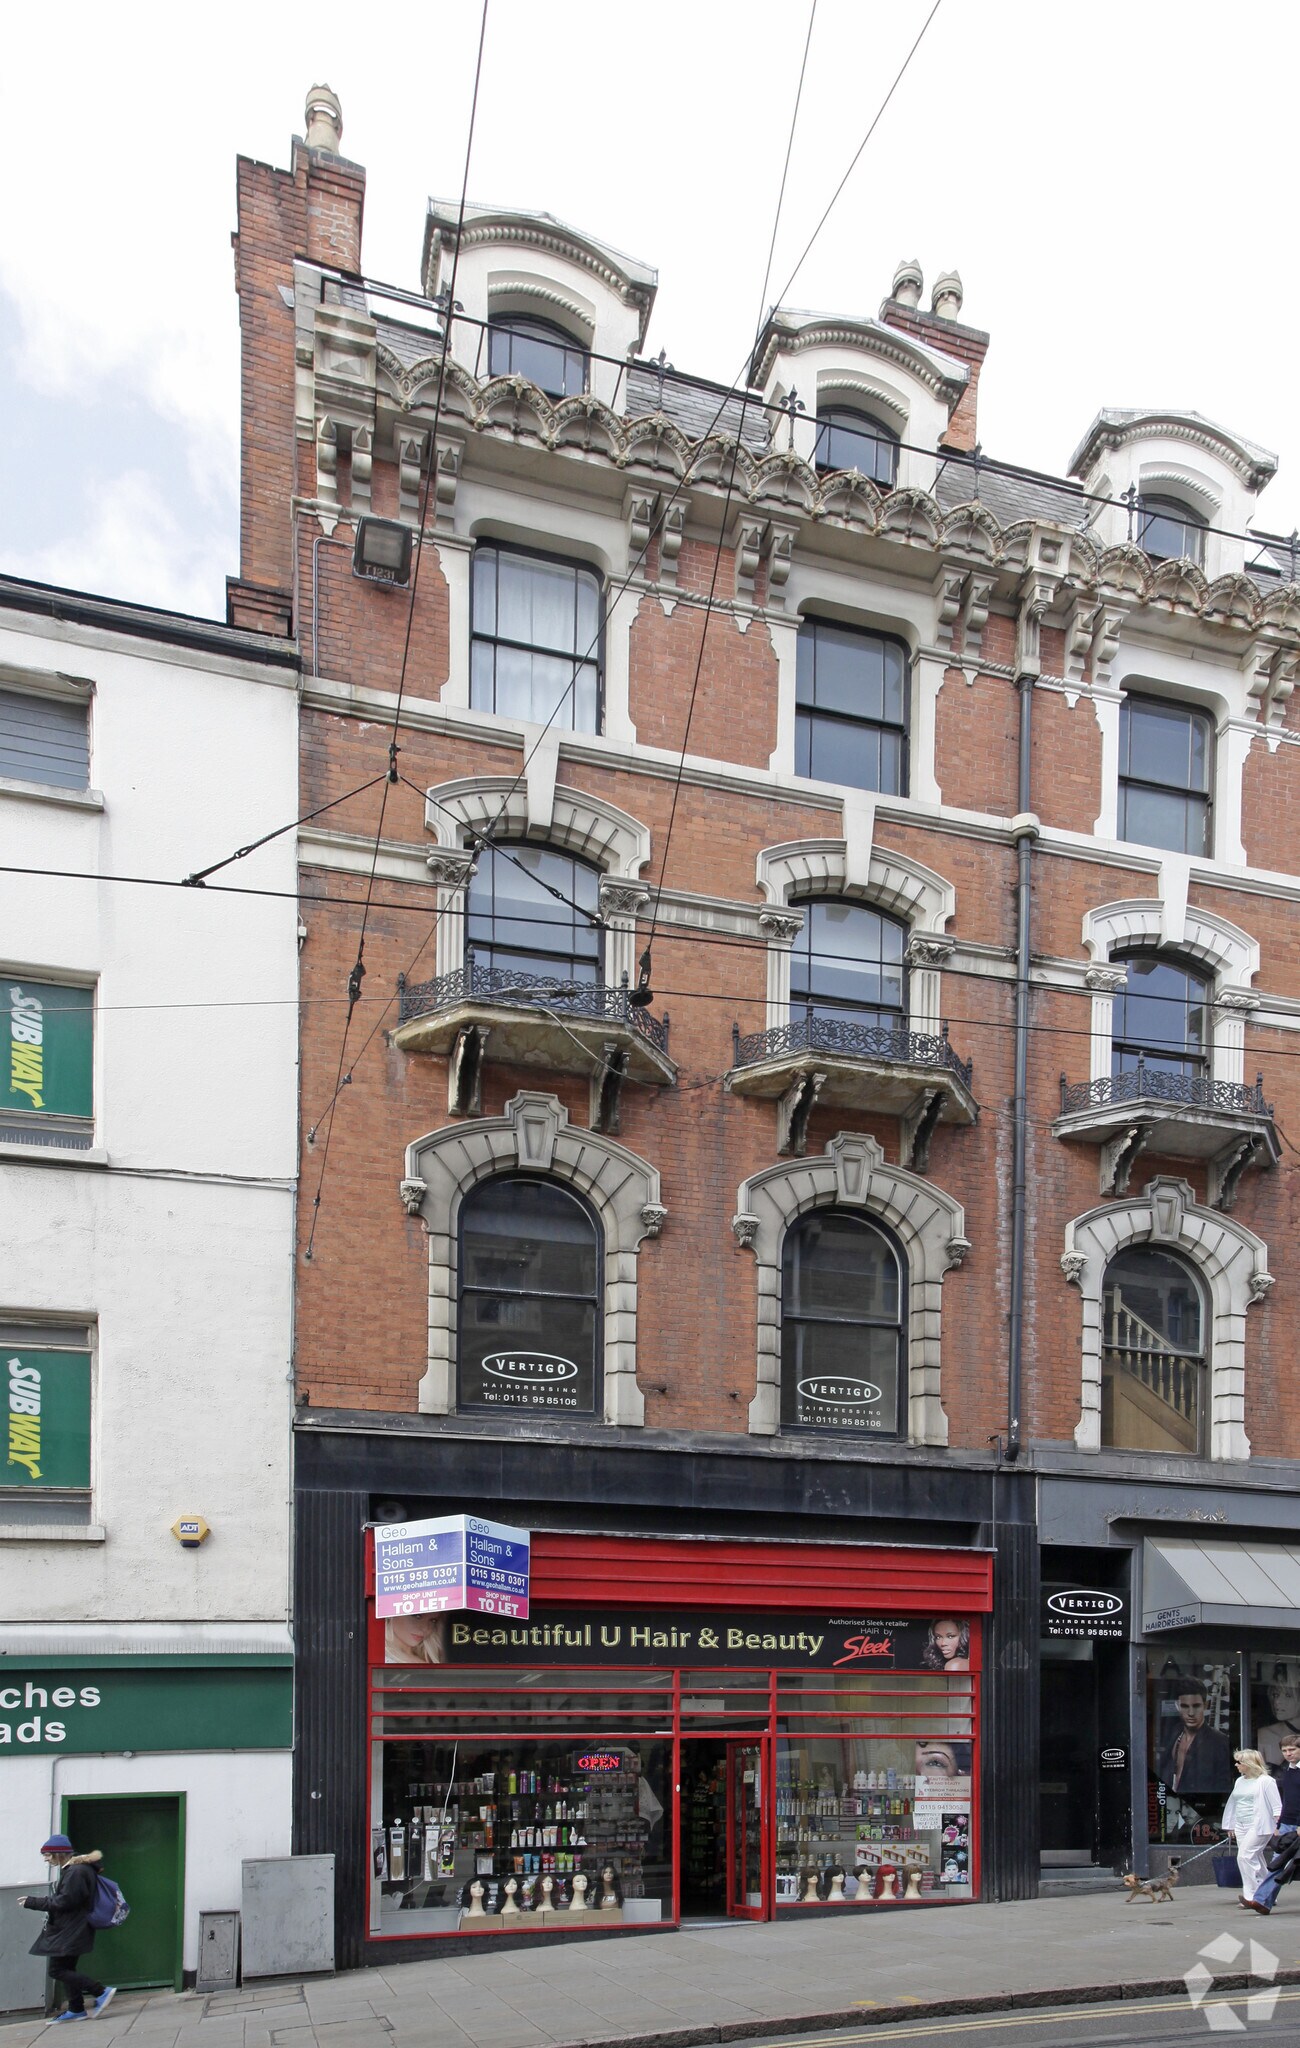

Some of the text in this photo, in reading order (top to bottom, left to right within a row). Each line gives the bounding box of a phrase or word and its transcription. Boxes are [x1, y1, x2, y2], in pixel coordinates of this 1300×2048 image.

[9, 986, 45, 1108] SUBWAY
[495, 1358, 566, 1375] VERTIGO
[482, 1382, 577, 1394] HAIRDRESSING
[809, 1382, 872, 1398] VERTIGO
[483, 1392, 501, 1401] Tel:
[503, 1394, 528, 1402] 0115
[7, 1357, 44, 1479] SUBWAY
[797, 1405, 881, 1416] HAIRDRESSING
[798, 1414, 814, 1423] Tel:
[816, 1416, 838, 1424] 0115
[381, 1527, 408, 1539] Geo
[469, 1518, 490, 1535] Geo
[382, 1538, 438, 1557] Hallam &
[470, 1536, 513, 1558] Hallam &
[382, 1557, 414, 1571] Sons
[470, 1551, 495, 1566] Sons
[383, 1567, 458, 1585] 0115 958 0301
[470, 1567, 525, 1587] 0115 958 0301
[384, 1577, 457, 1592] www.geohallam.co.uk
[471, 1579, 525, 1595] www.geohallam.co.uk
[402, 1592, 420, 1600] SHOP
[485, 1591, 511, 1601] SHOP UNIT
[1058, 1597, 1114, 1610] VERTIGO
[393, 1597, 448, 1615] TO LET
[478, 1597, 519, 1615] TO LET
[1145, 1615, 1196, 1631] HAIRDRESSING
[1157, 1609, 1181, 1621] GENTS
[883, 1628, 893, 1637] by
[1049, 1627, 1063, 1635] Tel:
[451, 1623, 824, 1656] Beautiful U Hair & Beauty
[832, 1635, 895, 1666] Sleek
[0, 1682, 101, 1709] ches
[578, 1757, 620, 1769] OPEN
[1157, 1782, 1166, 1806] offer
